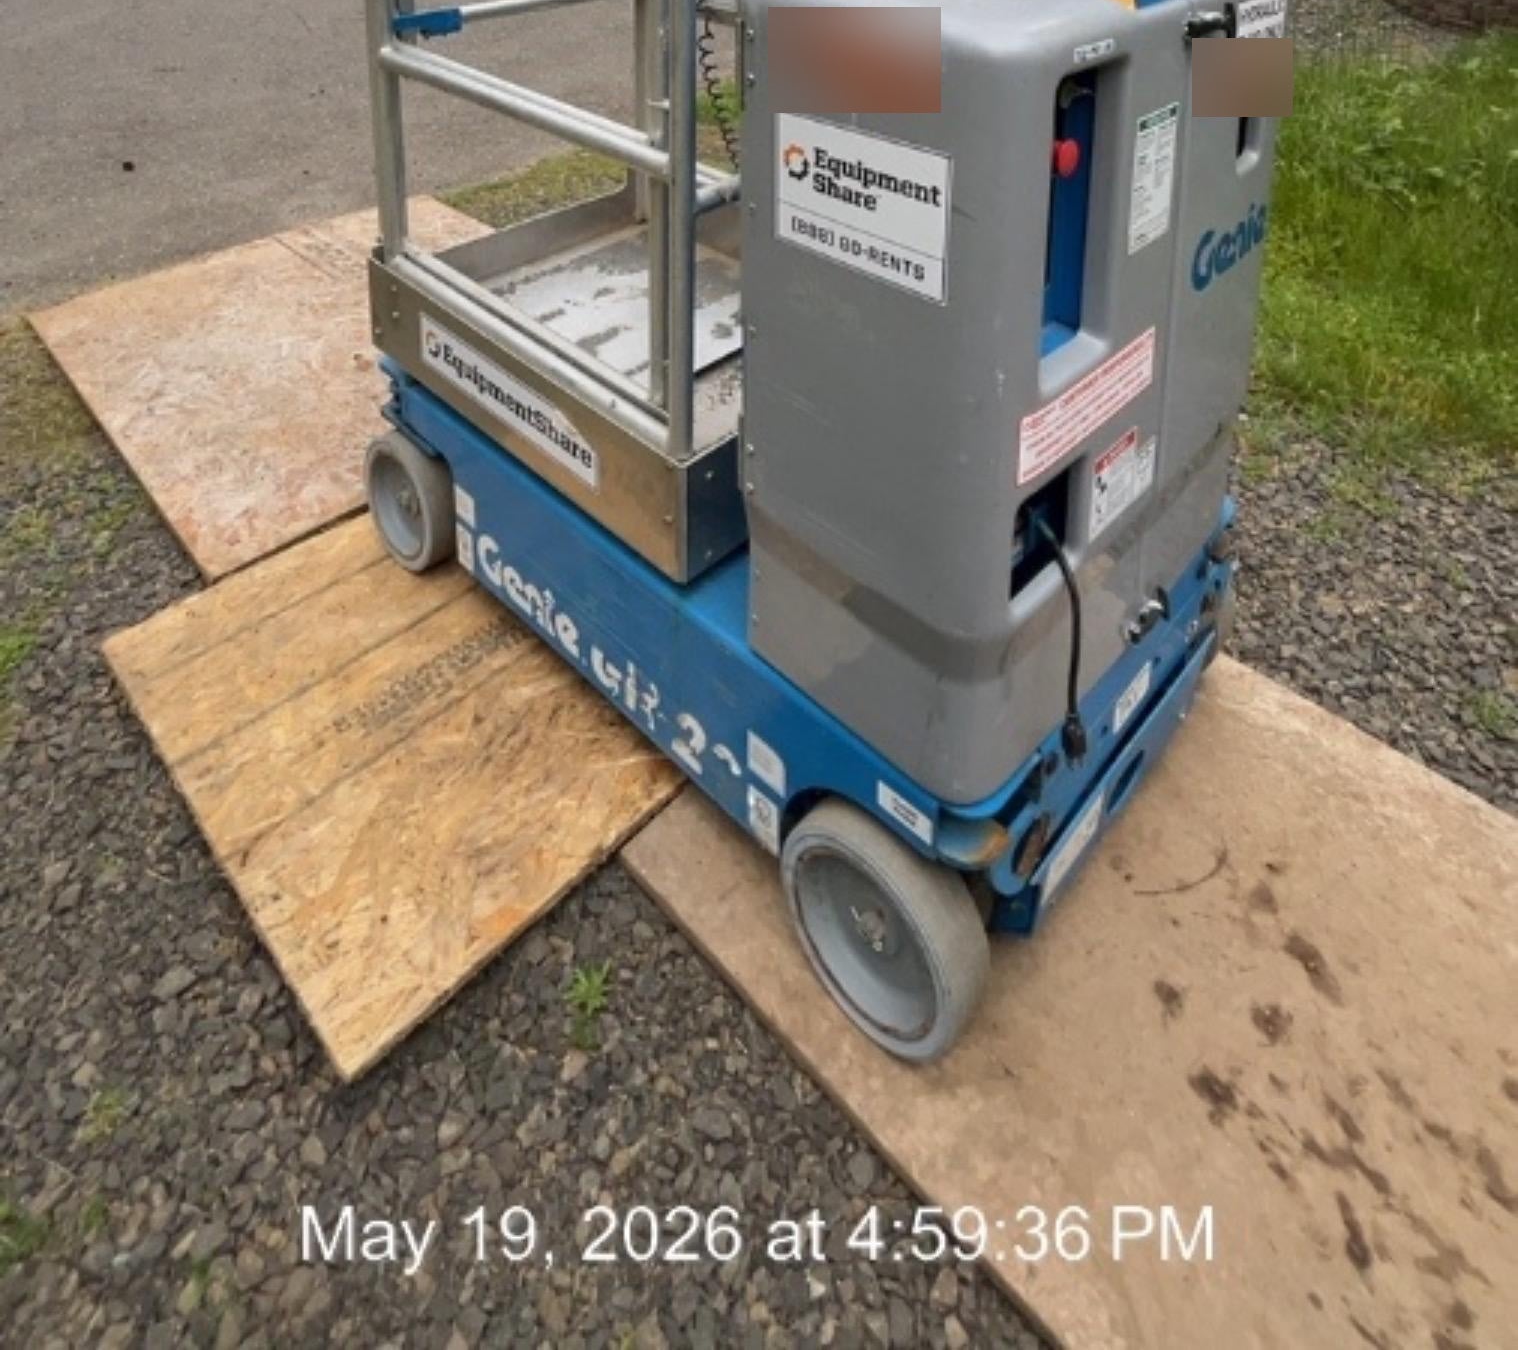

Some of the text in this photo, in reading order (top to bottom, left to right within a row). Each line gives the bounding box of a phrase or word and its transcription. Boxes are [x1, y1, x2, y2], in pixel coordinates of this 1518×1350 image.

[812, 172, 878, 211] Share
[814, 146, 942, 208] Equipment
[1192, 202, 1267, 292] Genie
[443, 344, 593, 469] EquipmentShare
[476, 534, 580, 658] Genie
